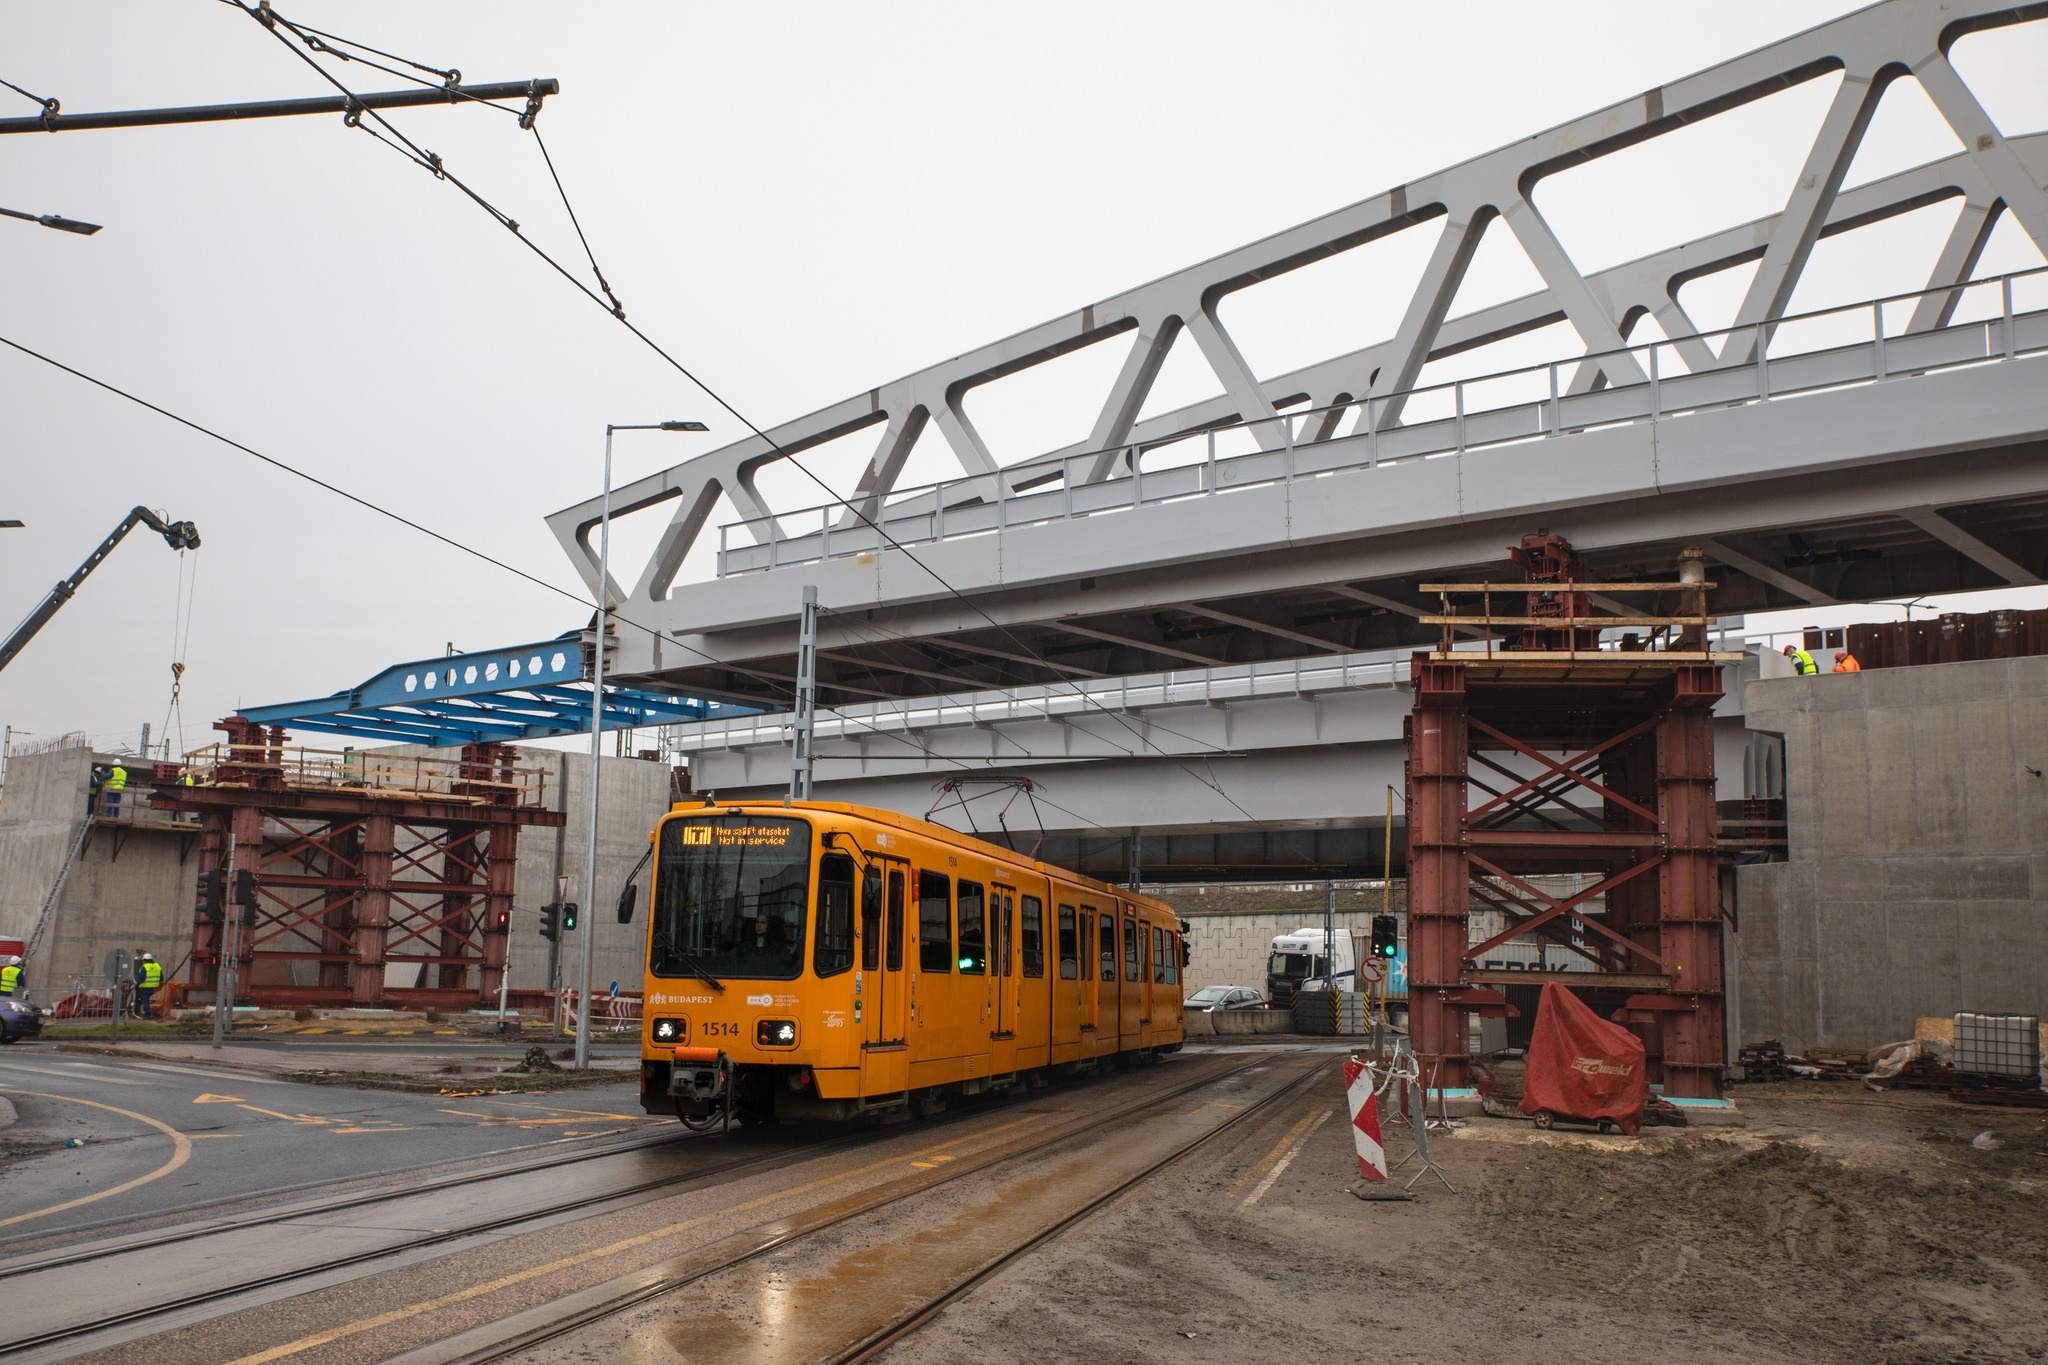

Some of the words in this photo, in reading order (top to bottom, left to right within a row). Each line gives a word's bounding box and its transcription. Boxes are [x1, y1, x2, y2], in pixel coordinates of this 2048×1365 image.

[758, 826, 790, 836] utasokat
[719, 836, 735, 845] Not
[737, 836, 746, 845] in
[747, 836, 786, 845] service
[668, 995, 714, 1004] BUDAPEST
[702, 1022, 740, 1037] 1514
